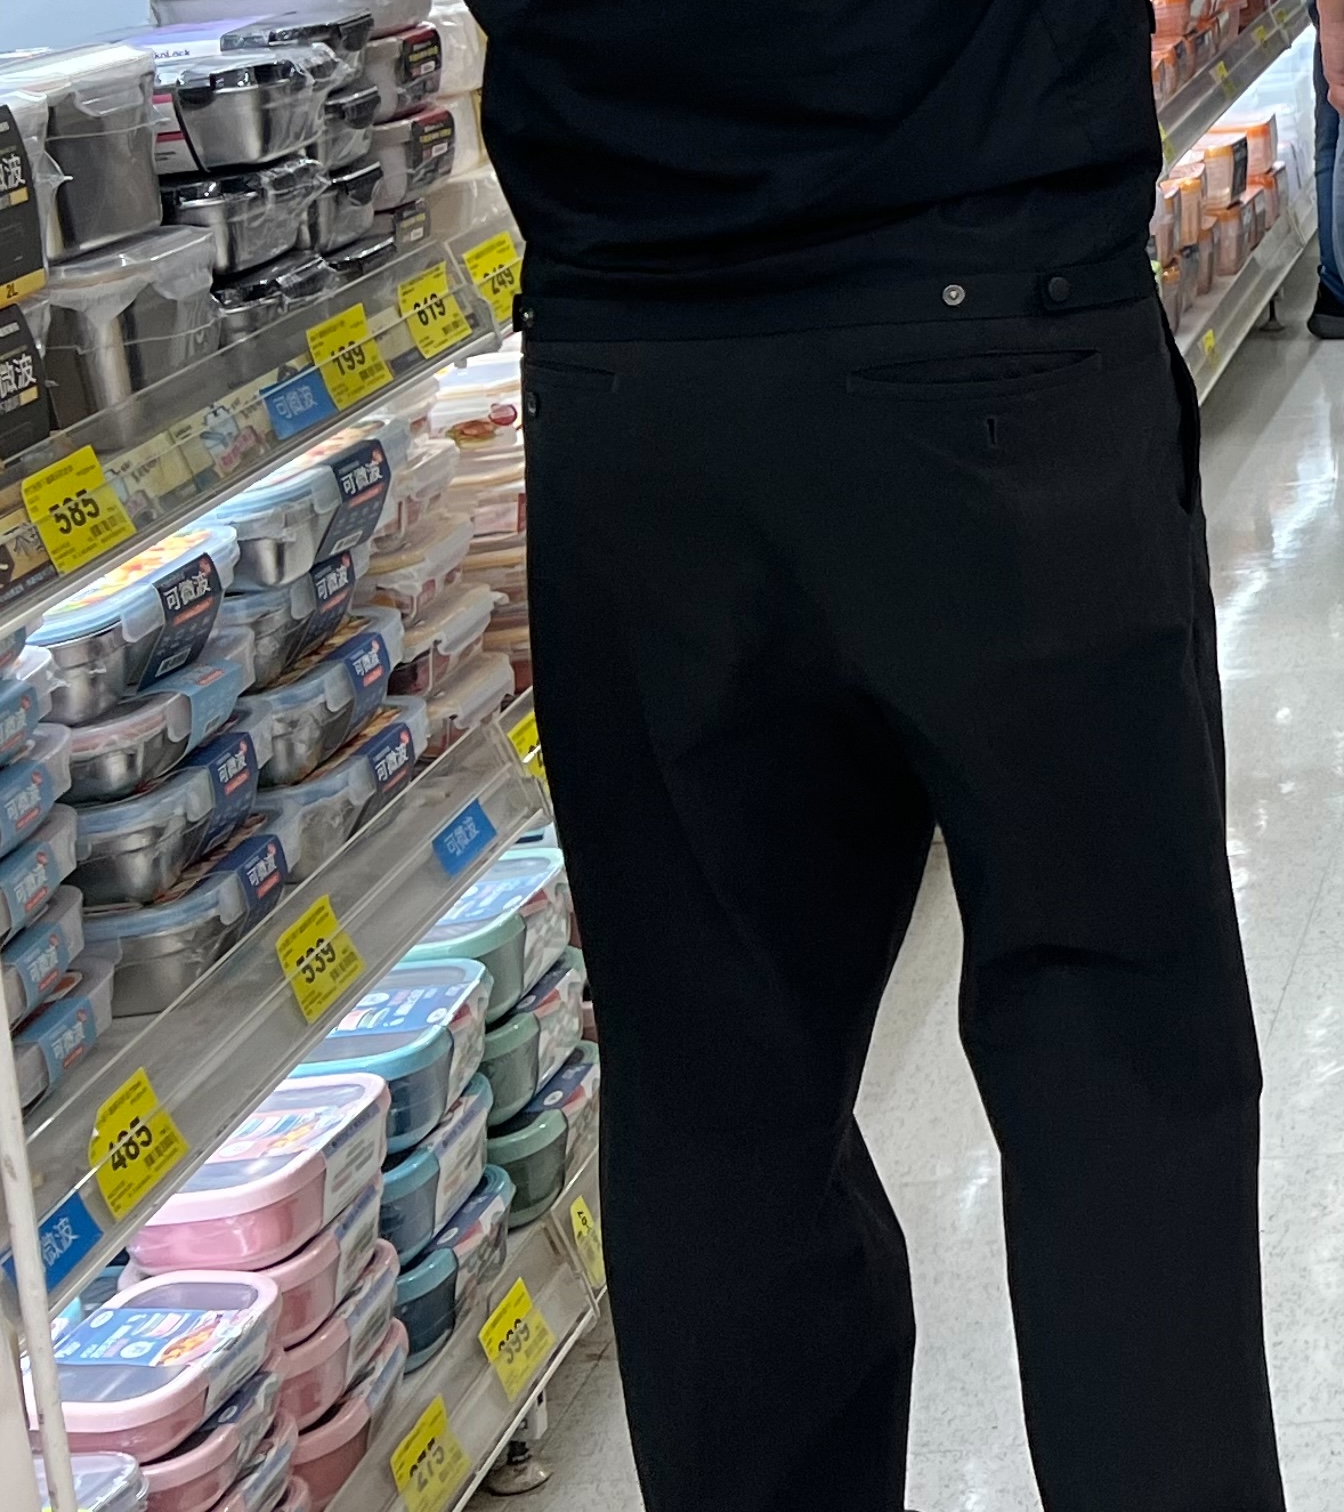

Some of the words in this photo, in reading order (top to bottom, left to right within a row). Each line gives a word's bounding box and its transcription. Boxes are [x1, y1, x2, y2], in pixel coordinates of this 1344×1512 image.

[412, 291, 447, 326] 619
[330, 338, 366, 375] 199
[274, 381, 316, 418] 可微波
[341, 460, 384, 495] 可微波
[49, 491, 101, 538] 585
[166, 570, 213, 611] 可微波
[315, 565, 353, 602] 可微波
[216, 744, 248, 784] 可微波
[374, 741, 411, 781] 可微波
[247, 849, 281, 886] 可微波
[107, 1118, 153, 1172] 485
